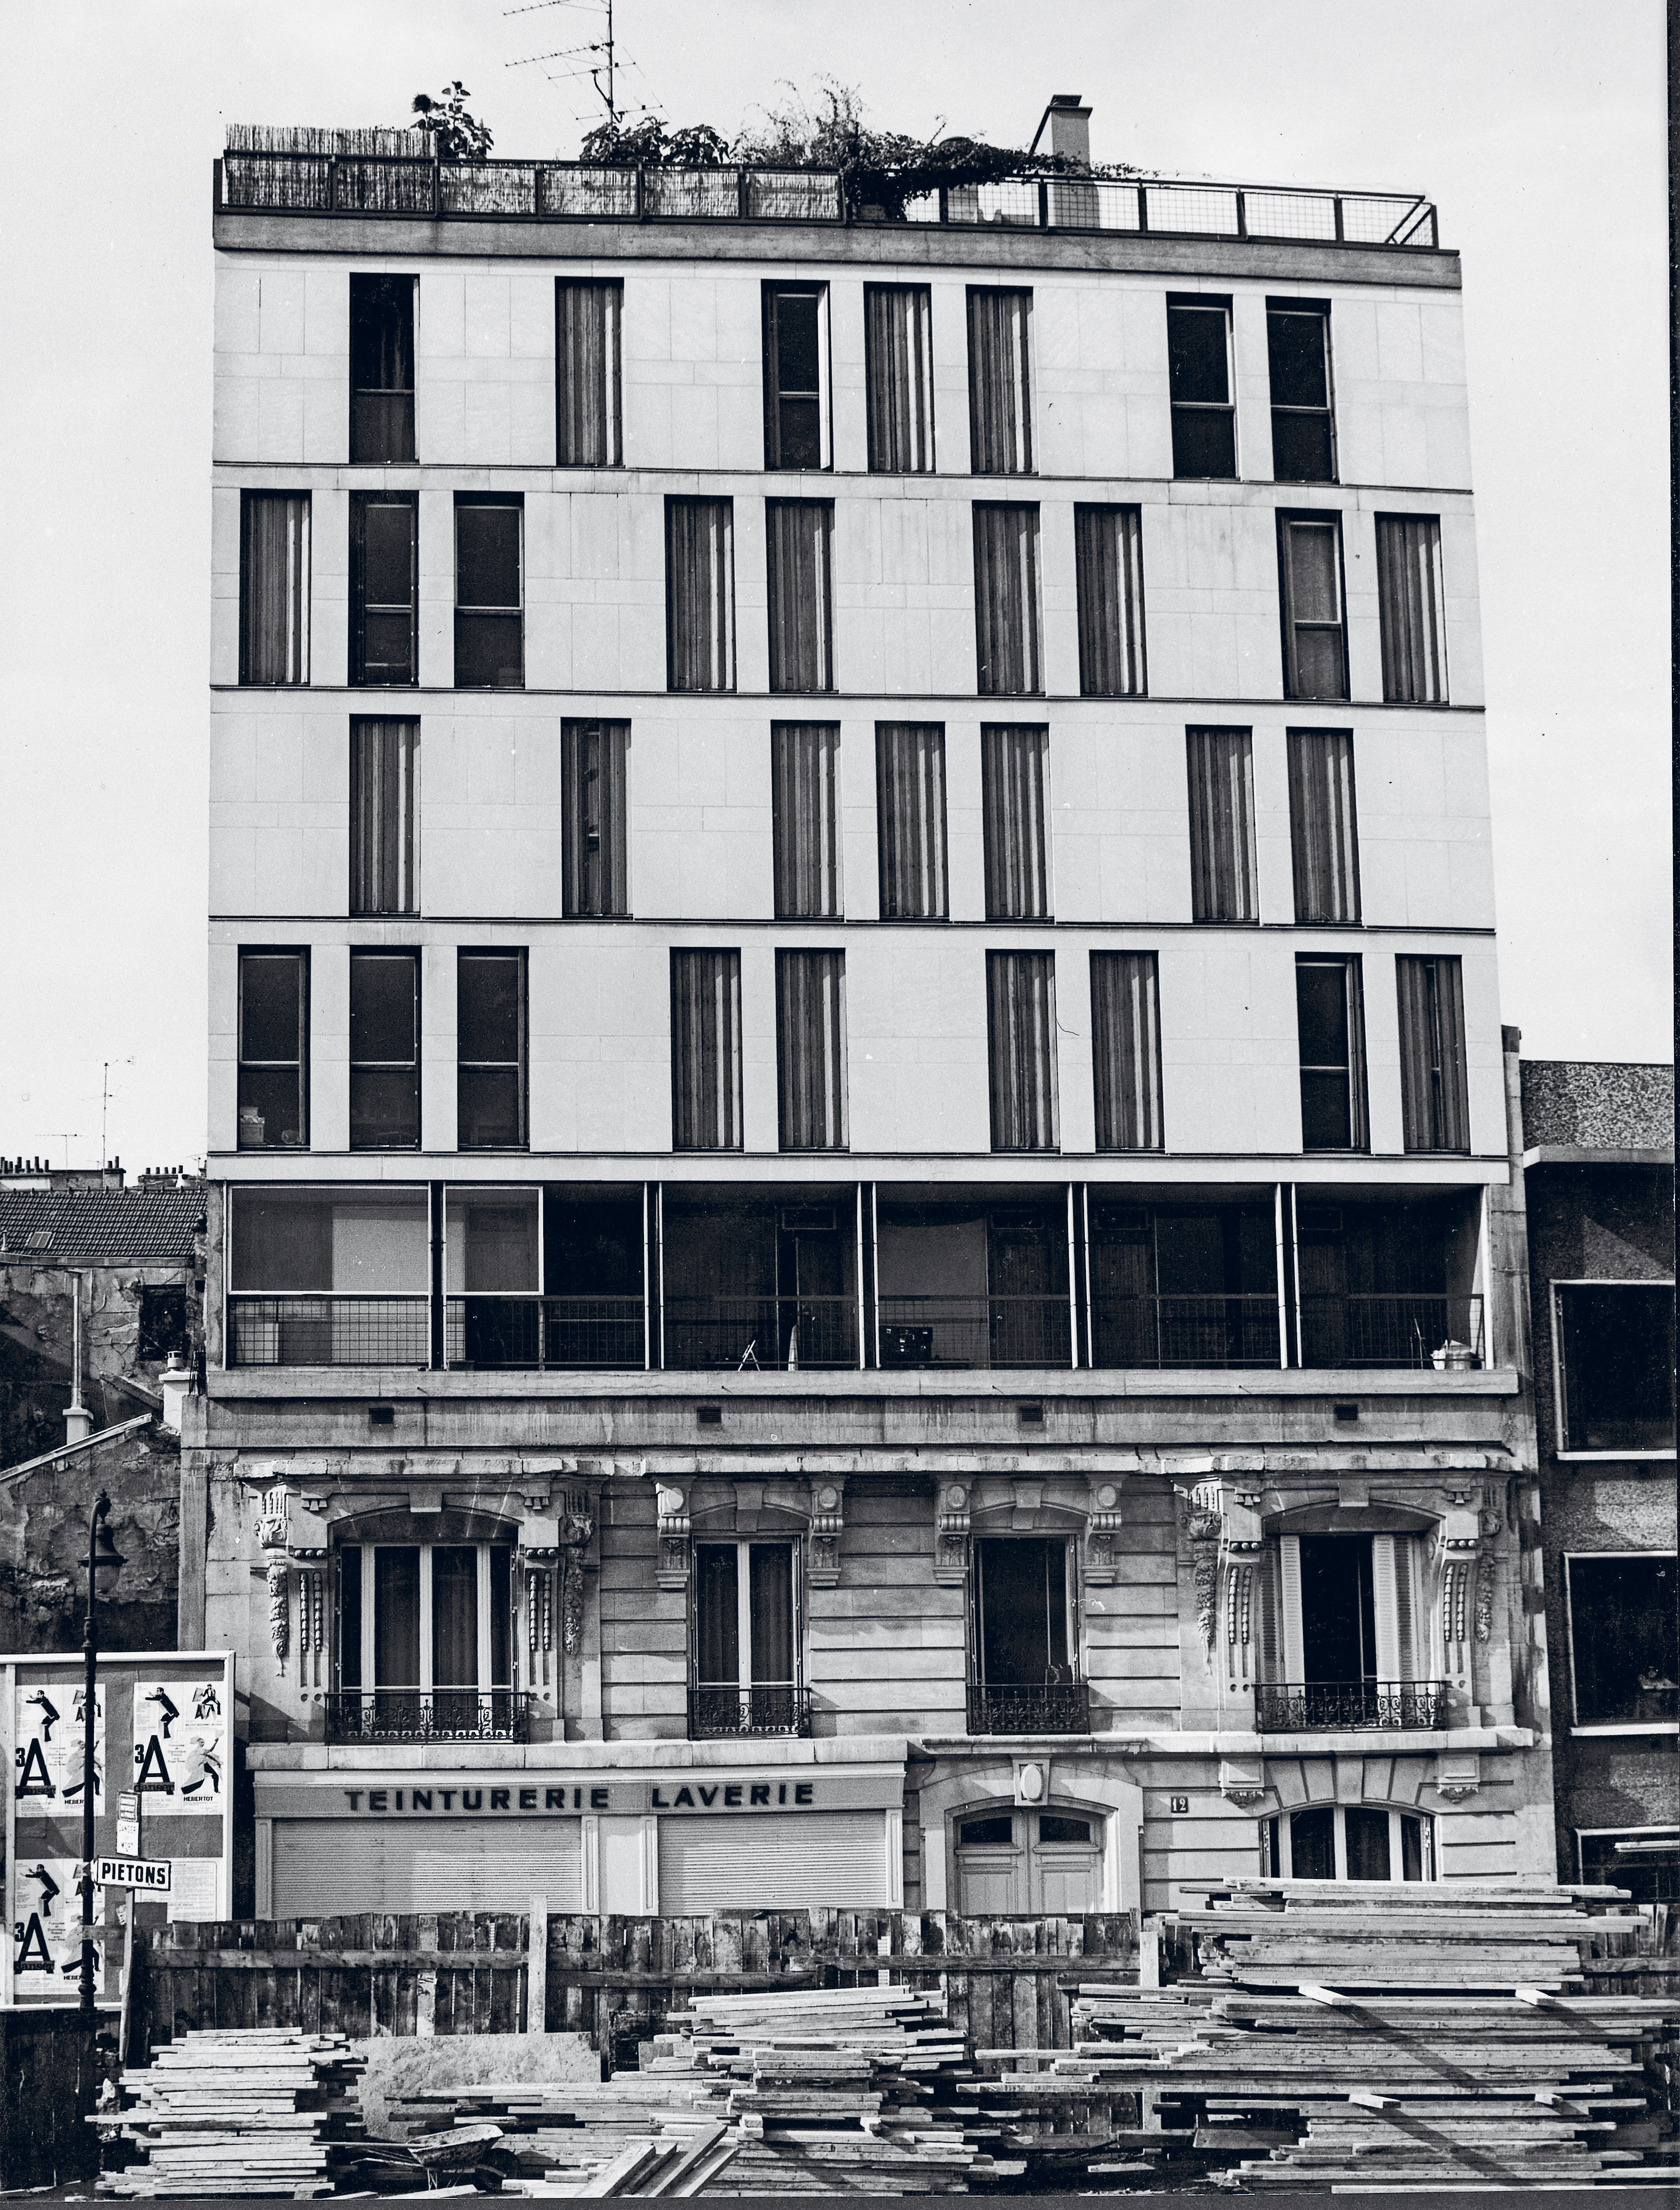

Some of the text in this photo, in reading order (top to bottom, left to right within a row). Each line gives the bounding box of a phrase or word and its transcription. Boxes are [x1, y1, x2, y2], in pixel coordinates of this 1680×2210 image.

[15, 1747, 25, 1767] 3
[135, 1744, 144, 1763] 3
[16, 1738, 55, 1799] A
[137, 1735, 174, 1795] A
[345, 1784, 814, 1811] TEINTURERIE LAVERIE
[1172, 1798, 1186, 1811] 12
[102, 1863, 165, 1884] PIETONS
[15, 1922, 25, 1942] 3
[14, 1913, 54, 1974] A
